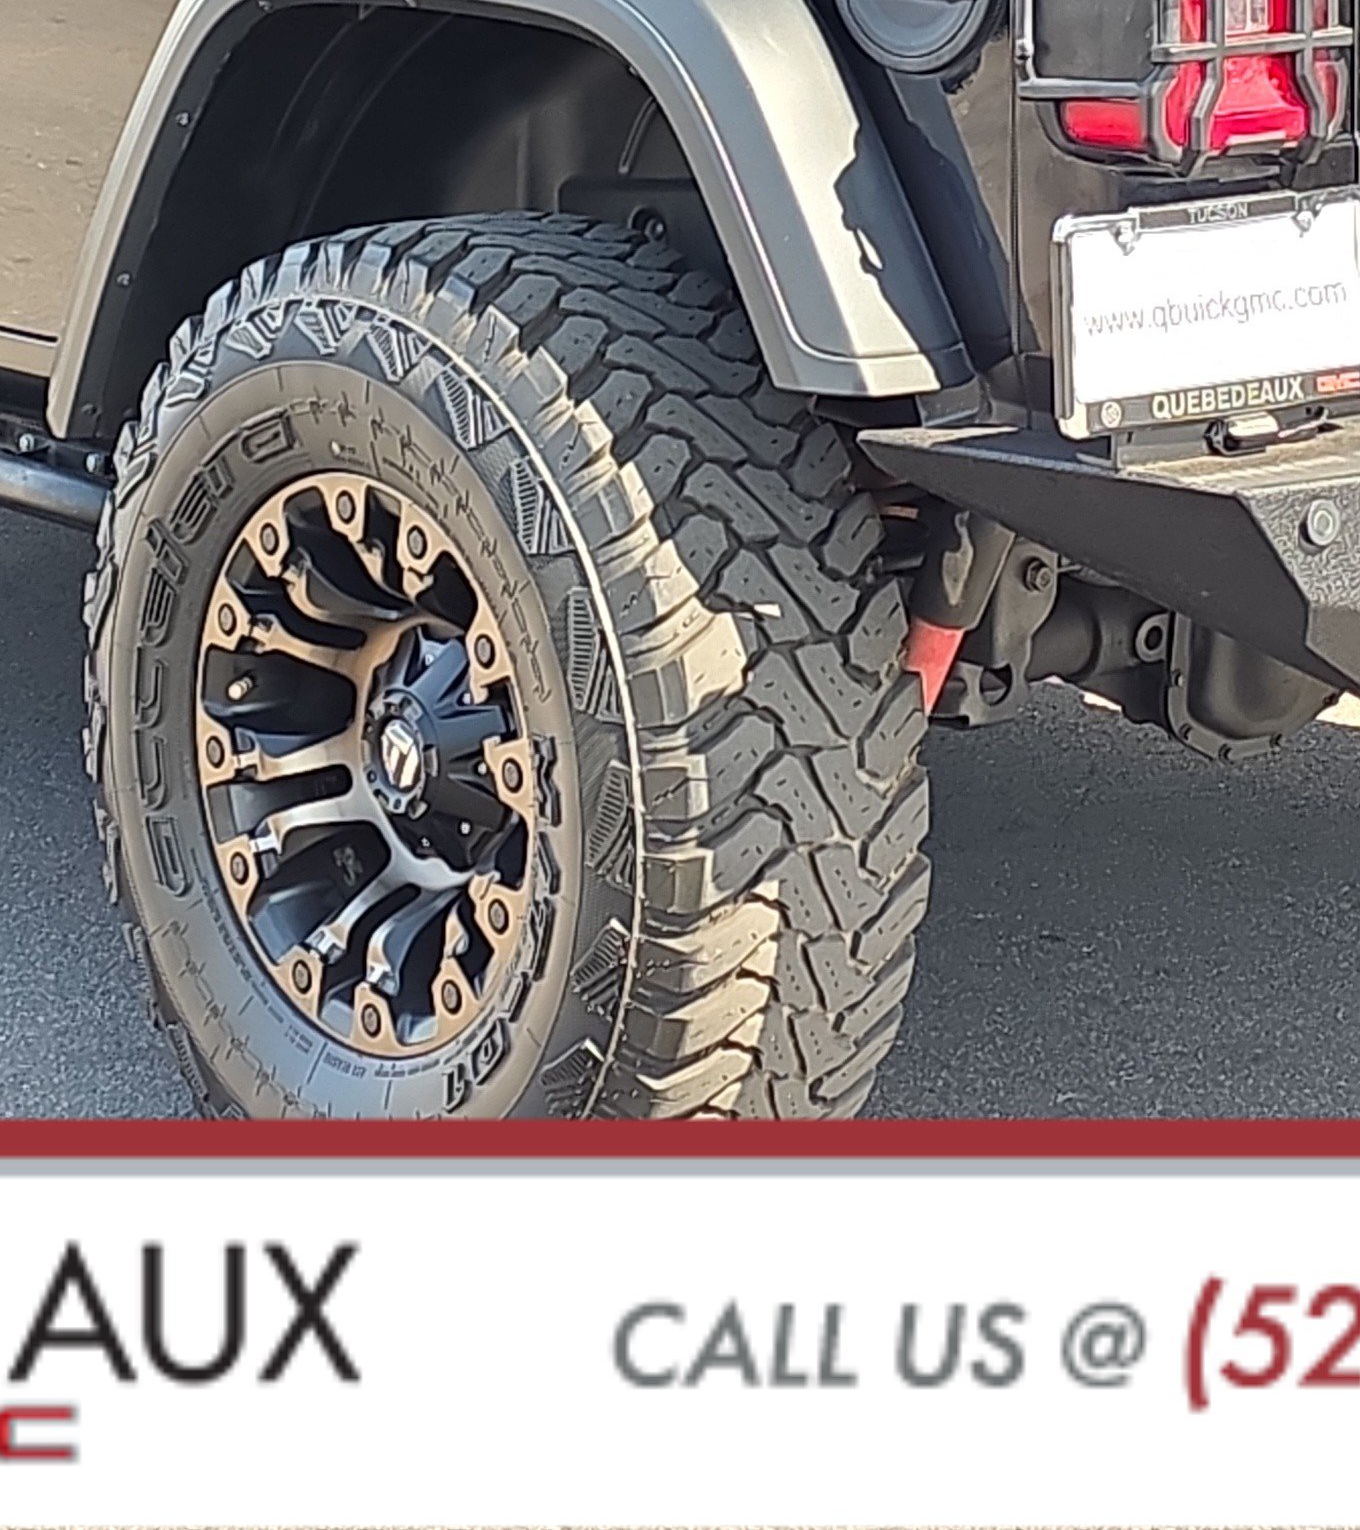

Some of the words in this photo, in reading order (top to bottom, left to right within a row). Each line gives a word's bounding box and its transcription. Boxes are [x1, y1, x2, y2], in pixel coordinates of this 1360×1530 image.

[1187, 202, 1250, 224] TUCSON
[1083, 281, 1347, 337] www.qbuickgmc.com
[1151, 375, 1305, 420] QUEBEDEAUX
